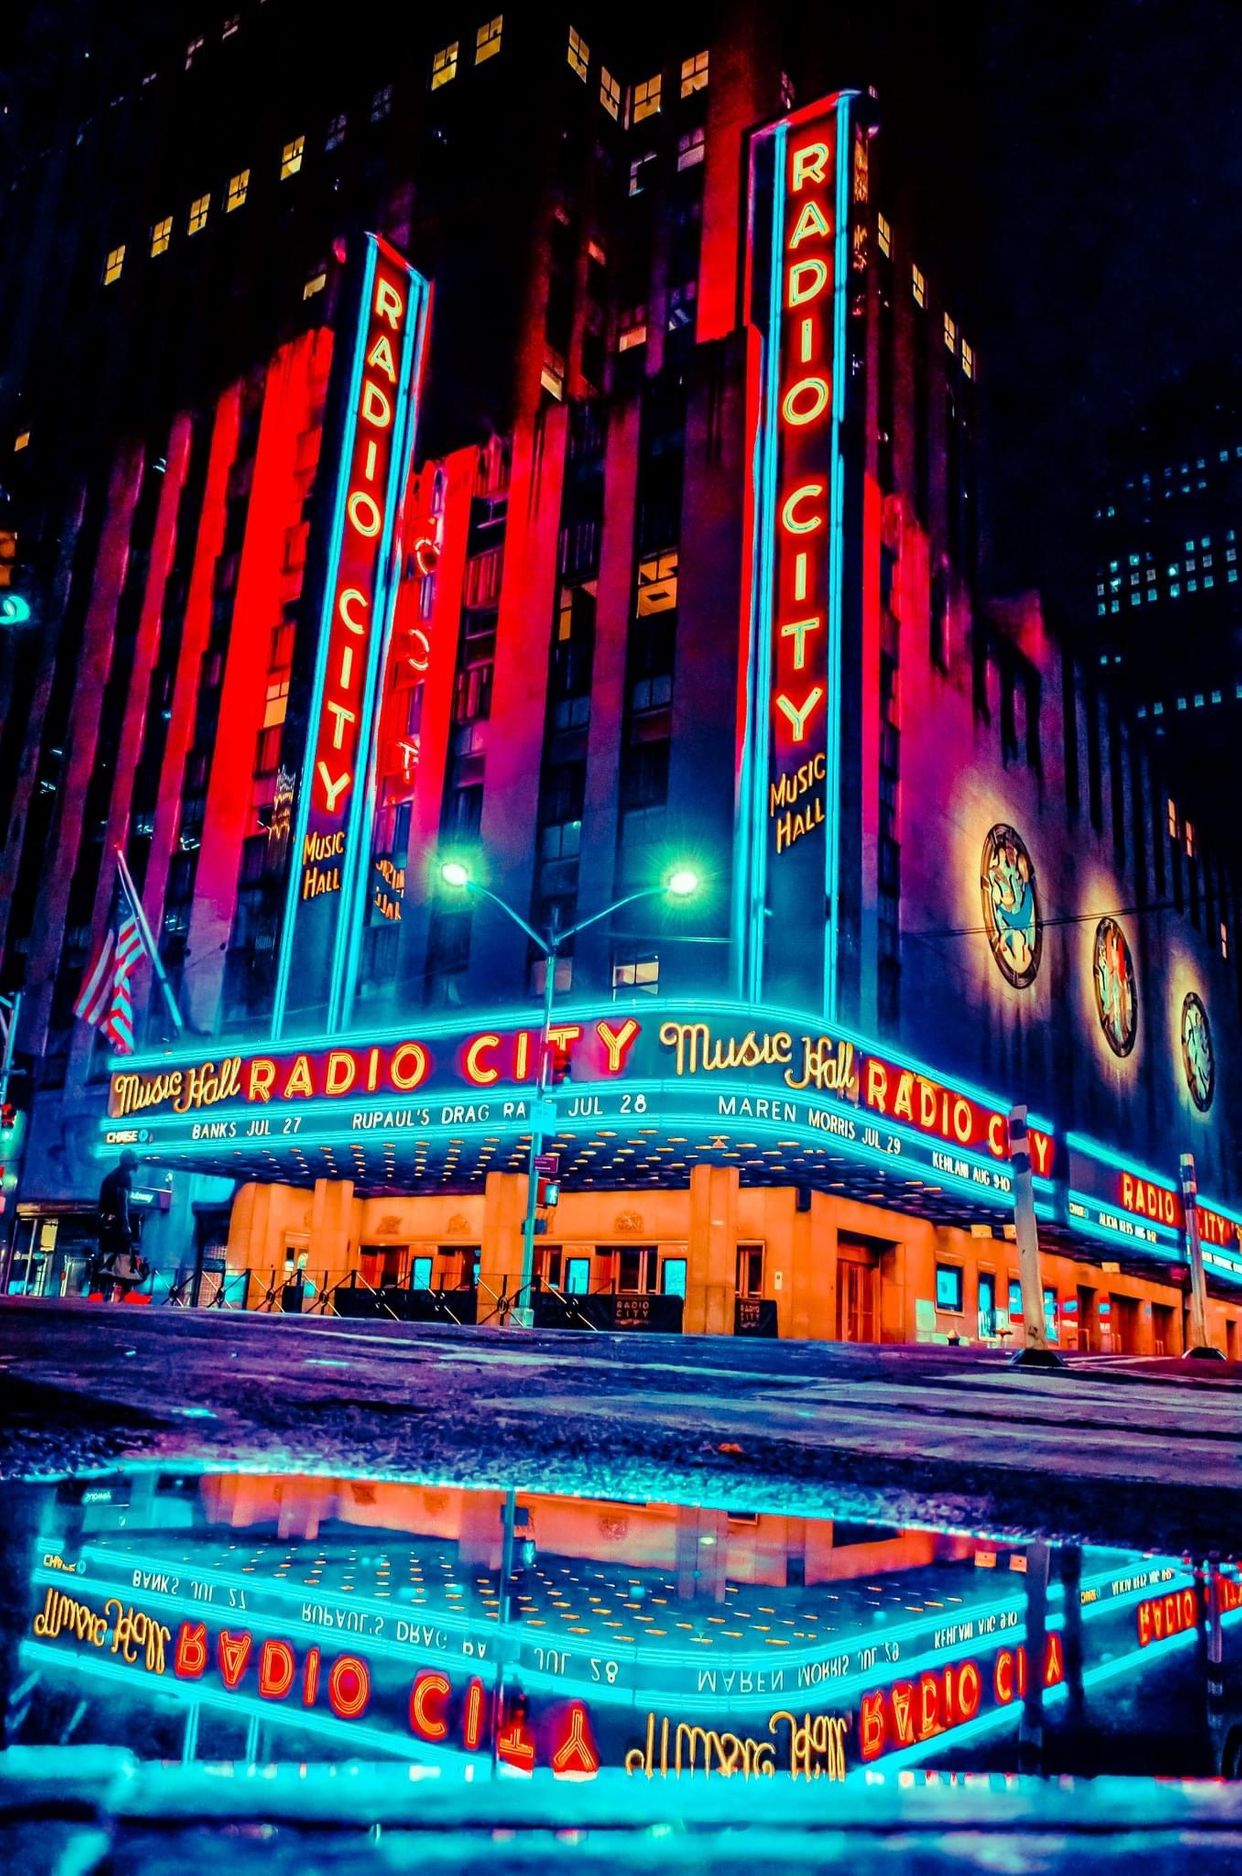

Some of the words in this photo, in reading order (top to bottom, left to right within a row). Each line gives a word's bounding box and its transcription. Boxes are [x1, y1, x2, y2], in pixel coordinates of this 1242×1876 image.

[781, 142, 830, 426] RADIO
[347, 277, 403, 538] RADIO
[775, 484, 824, 742] CITY
[316, 588, 369, 812] CITY
[770, 752, 827, 817] MUSIC
[302, 831, 345, 865] MUSIC
[775, 797, 826, 855] HALL
[303, 866, 342, 900] HALL
[114, 1070, 182, 1116] Music
[174, 1056, 242, 1113] Hall
[247, 1043, 428, 1103] RADIO
[659, 1022, 793, 1076] Music
[784, 1037, 856, 1090] Hall
[106, 1129, 138, 1143] CHASE
[192, 1121, 237, 1139] BANKS
[247, 1119, 271, 1136] JUL
[283, 1116, 302, 1134] 27
[352, 1108, 430, 1130] RUPAUL'S
[441, 1104, 490, 1124] DRAG
[568, 1097, 603, 1117] JUL
[620, 1094, 647, 1113] 28
[718, 1095, 796, 1122] MAREN
[808, 1108, 855, 1139] MORRIS
[862, 1127, 881, 1149] JUL
[886, 1136, 901, 1155] 29
[868, 1059, 973, 1142] RADIO
[988, 1114, 1048, 1173] CY
[932, 1151, 969, 1178] KEHLANI
[973, 1166, 990, 1185] AUG
[1122, 1172, 1176, 1225] RADIO
[1199, 1208, 1225, 1245] ITY
